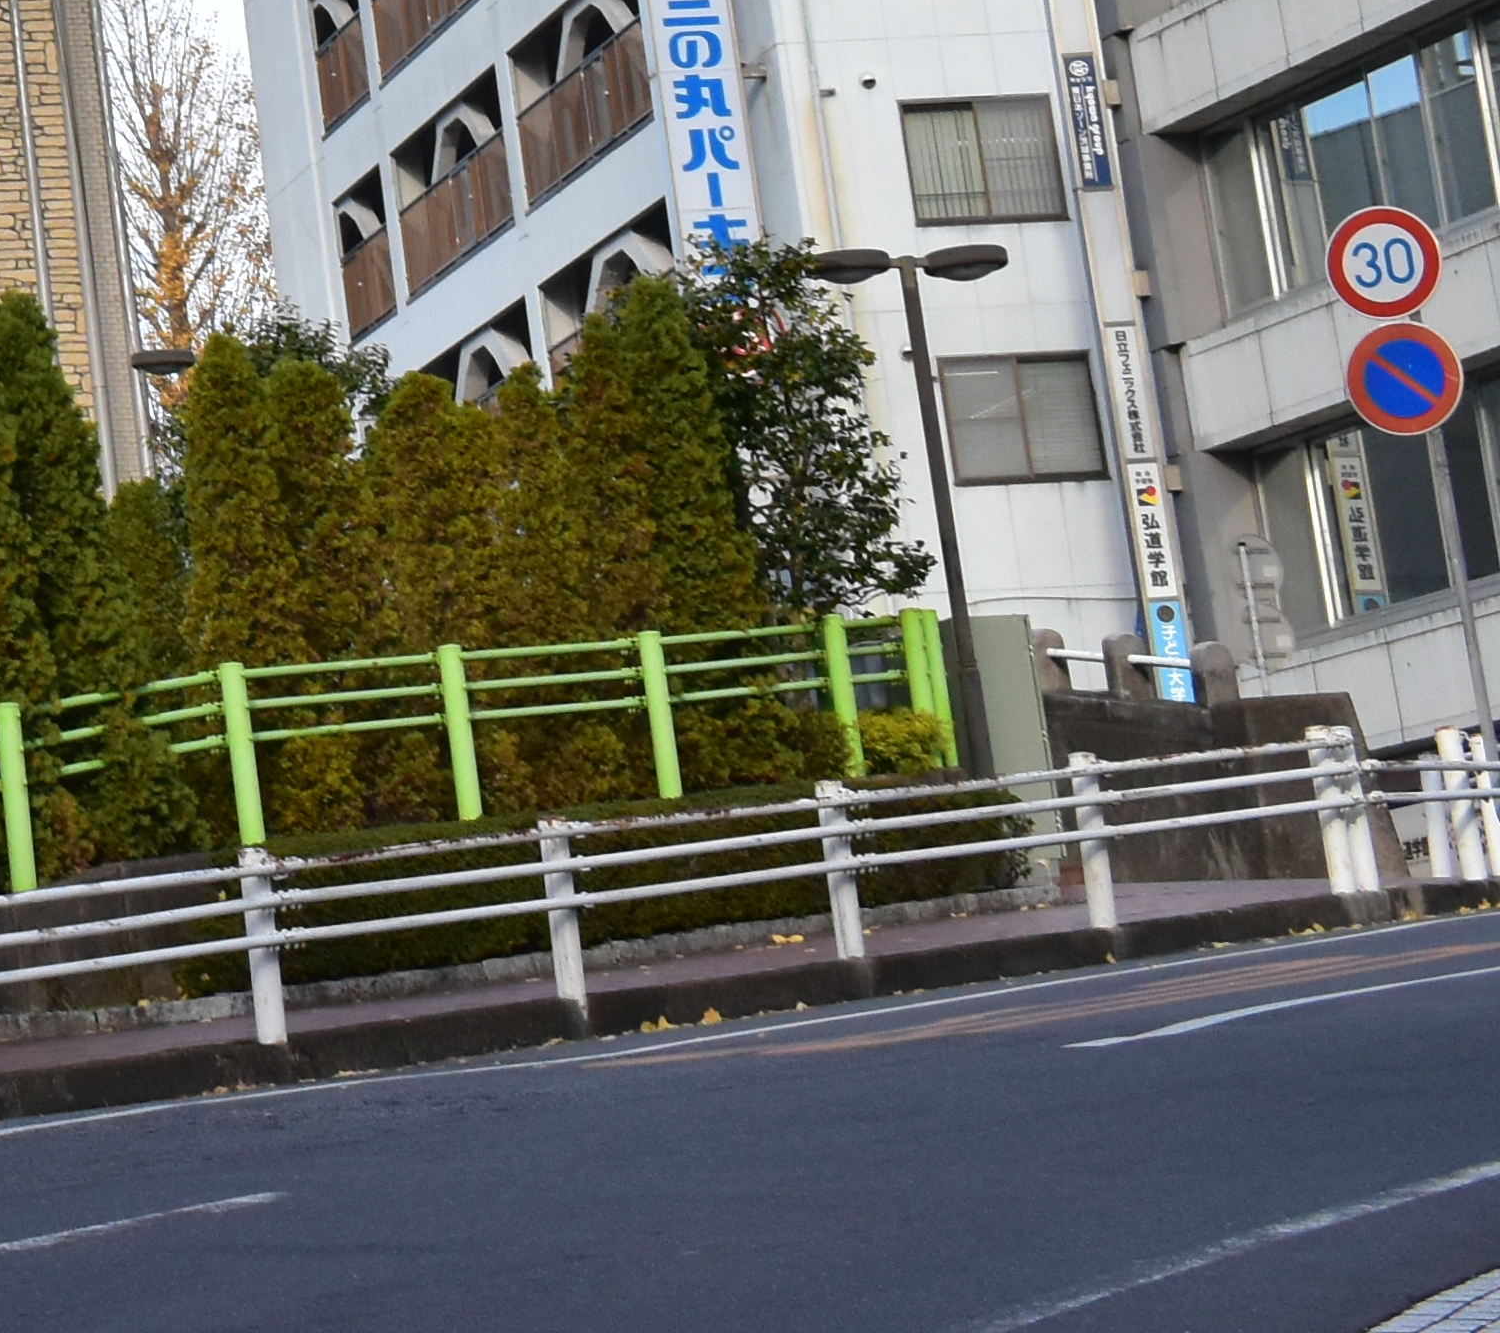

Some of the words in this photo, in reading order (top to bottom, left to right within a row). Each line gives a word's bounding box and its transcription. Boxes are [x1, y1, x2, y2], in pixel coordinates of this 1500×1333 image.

[1351, 237, 1416, 289] 30
[1141, 512, 1170, 588] 弘道学館
